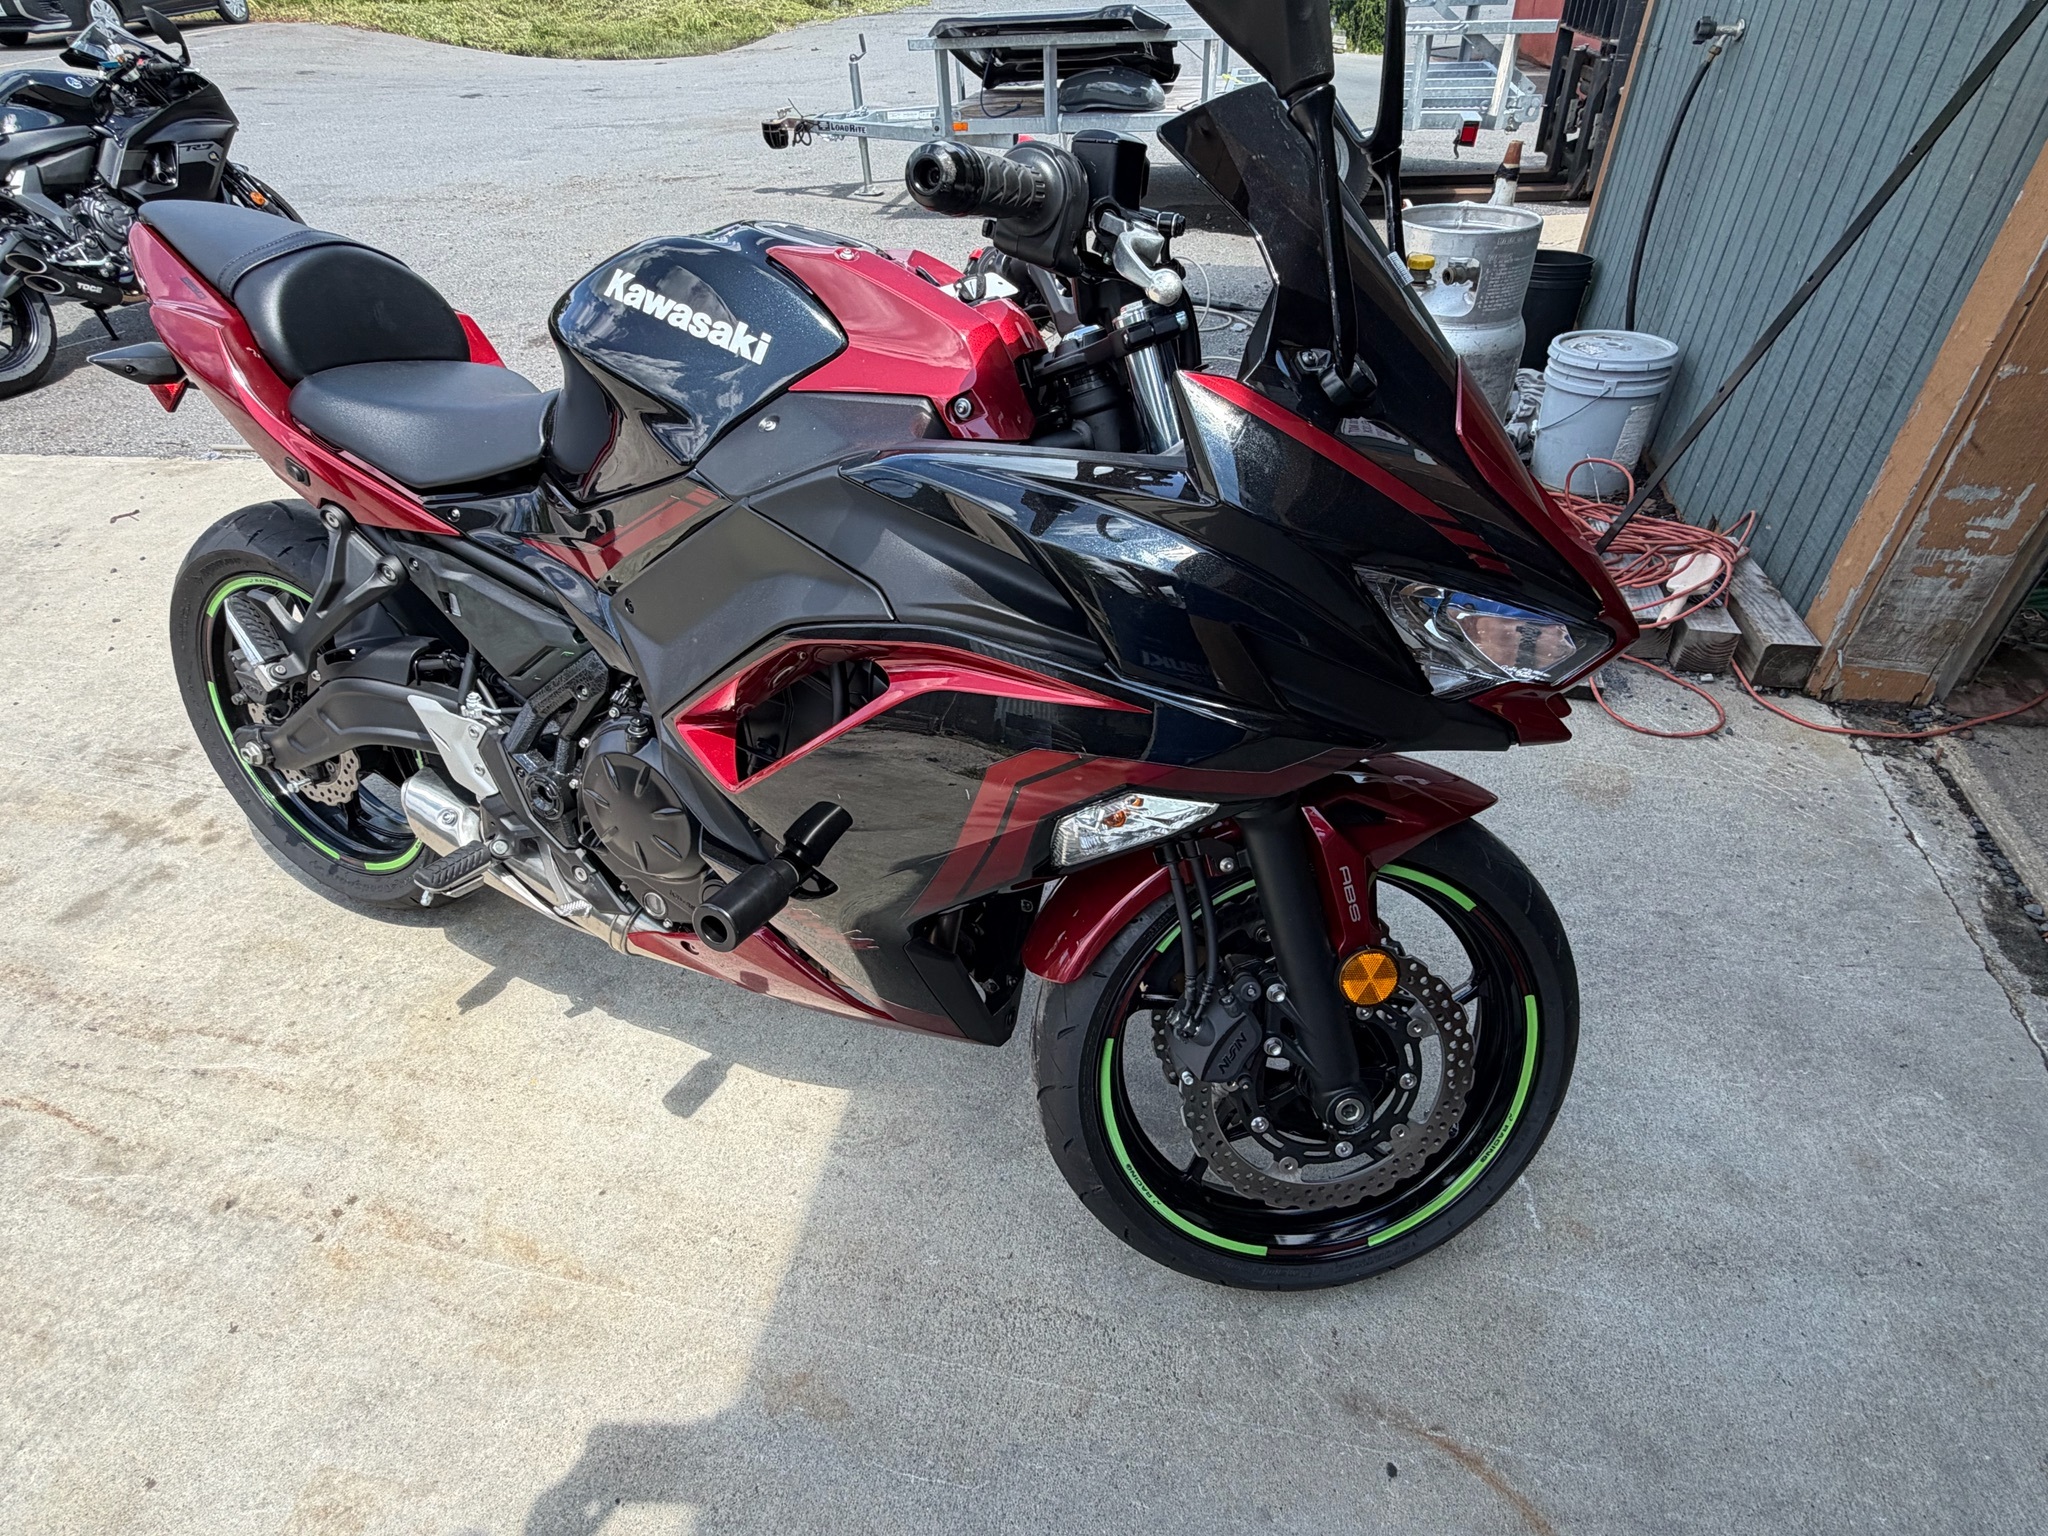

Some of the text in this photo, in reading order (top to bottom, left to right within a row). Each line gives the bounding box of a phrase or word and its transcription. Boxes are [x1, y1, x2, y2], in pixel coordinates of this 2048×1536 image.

[76, 281, 104, 294] TOCE
[603, 268, 773, 366] Kawasaki
[1339, 865, 1362, 922] ABS
[1480, 1124, 1510, 1163] RACING
[1126, 1163, 1153, 1199] RACING
